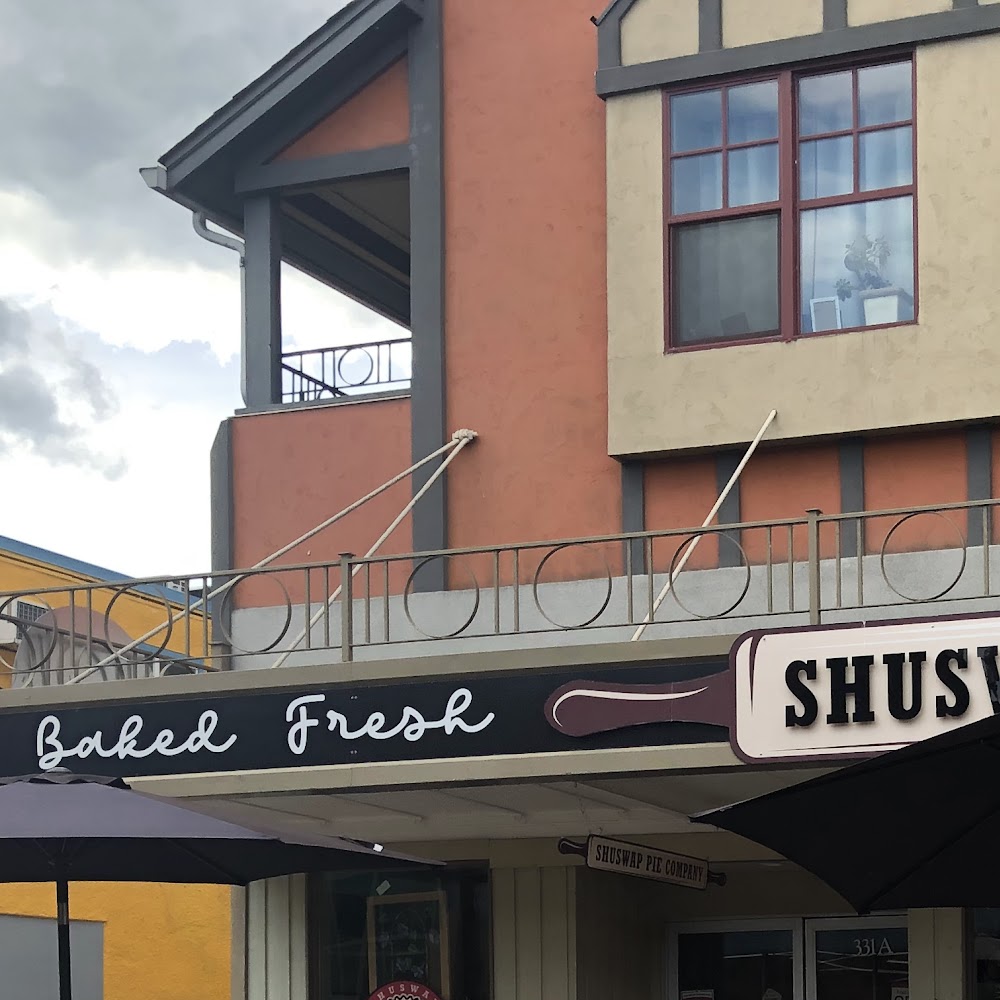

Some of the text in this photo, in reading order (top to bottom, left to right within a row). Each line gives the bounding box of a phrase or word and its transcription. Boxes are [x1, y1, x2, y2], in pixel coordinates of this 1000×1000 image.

[37, 688, 495, 770] Baked Fresh
[595, 844, 704, 882] SHUSWAP PIE COMPANY
